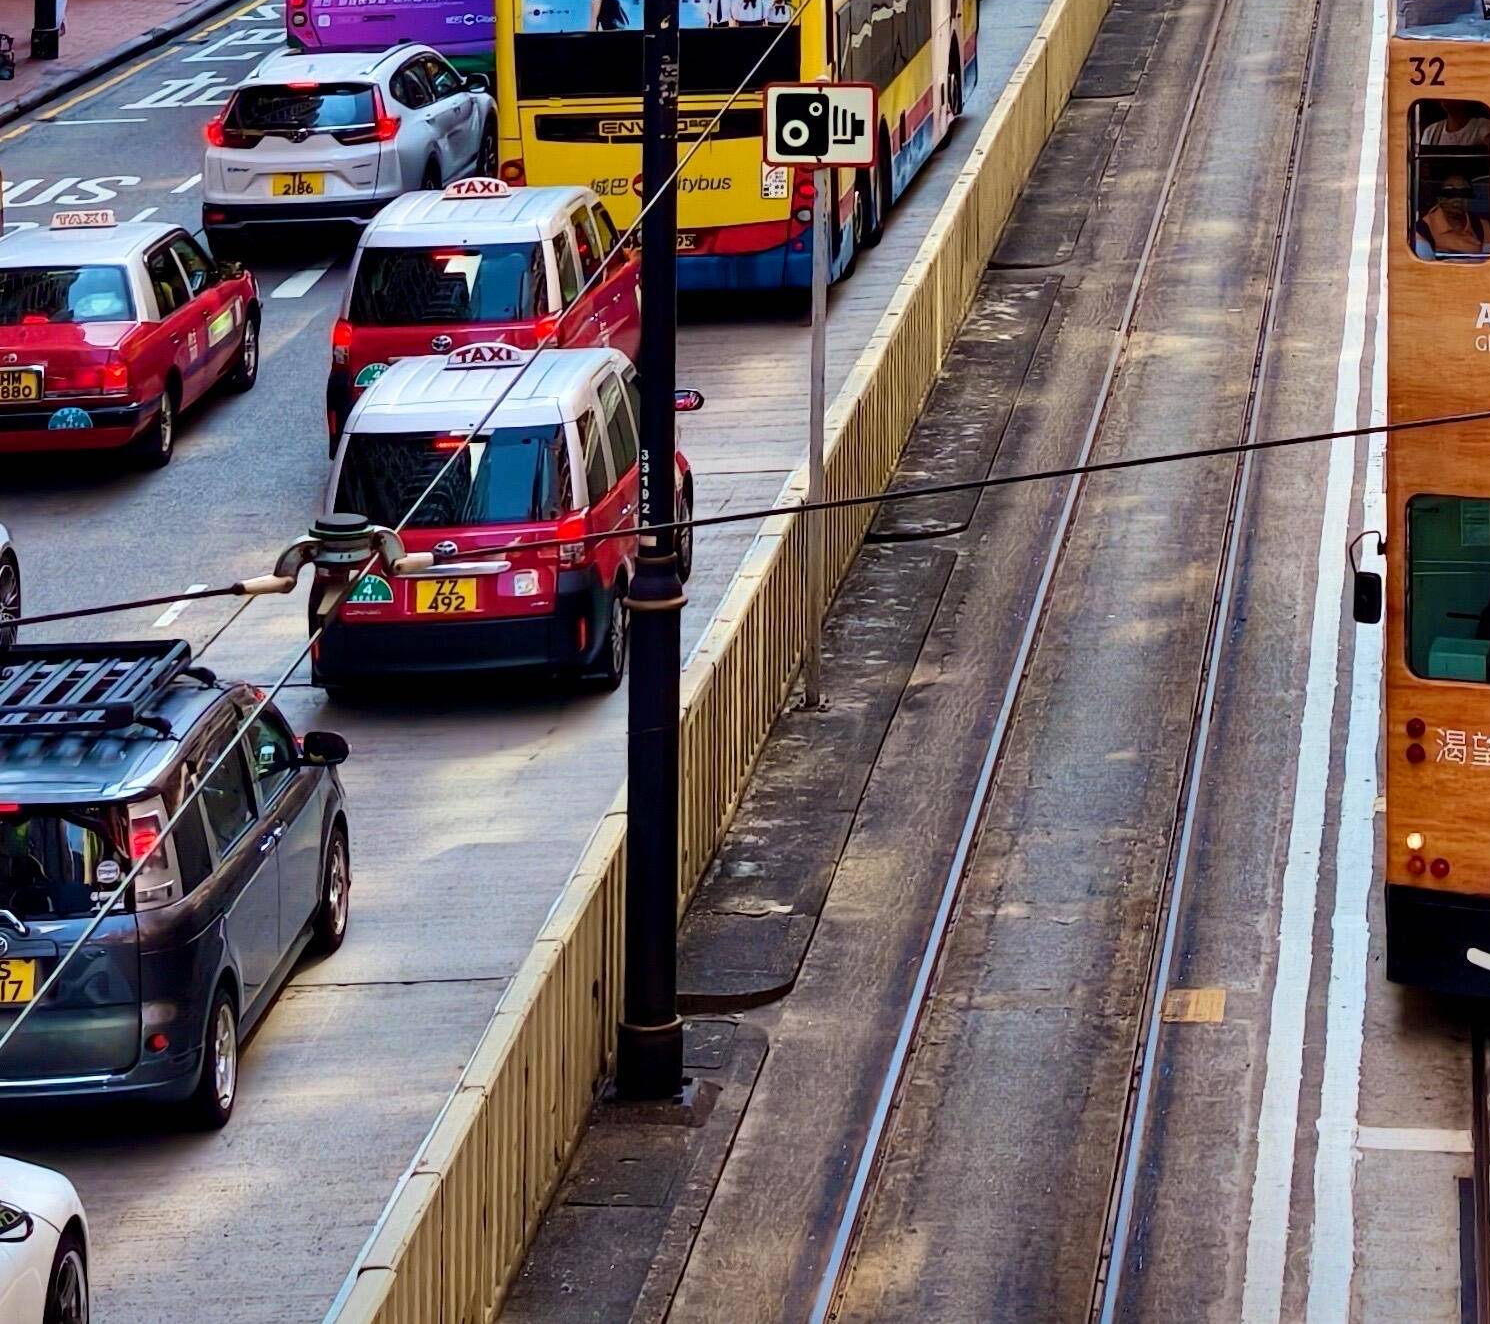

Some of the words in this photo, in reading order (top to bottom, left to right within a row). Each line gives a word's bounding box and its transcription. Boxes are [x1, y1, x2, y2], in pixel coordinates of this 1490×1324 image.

[1409, 57, 1446, 86] 32
[453, 181, 499, 195] TAXI
[677, 174, 732, 193] itybus
[56, 212, 109, 225] TAXI
[456, 347, 513, 364] TAXI
[435, 579, 459, 596] ZZ
[428, 595, 467, 612] 492
